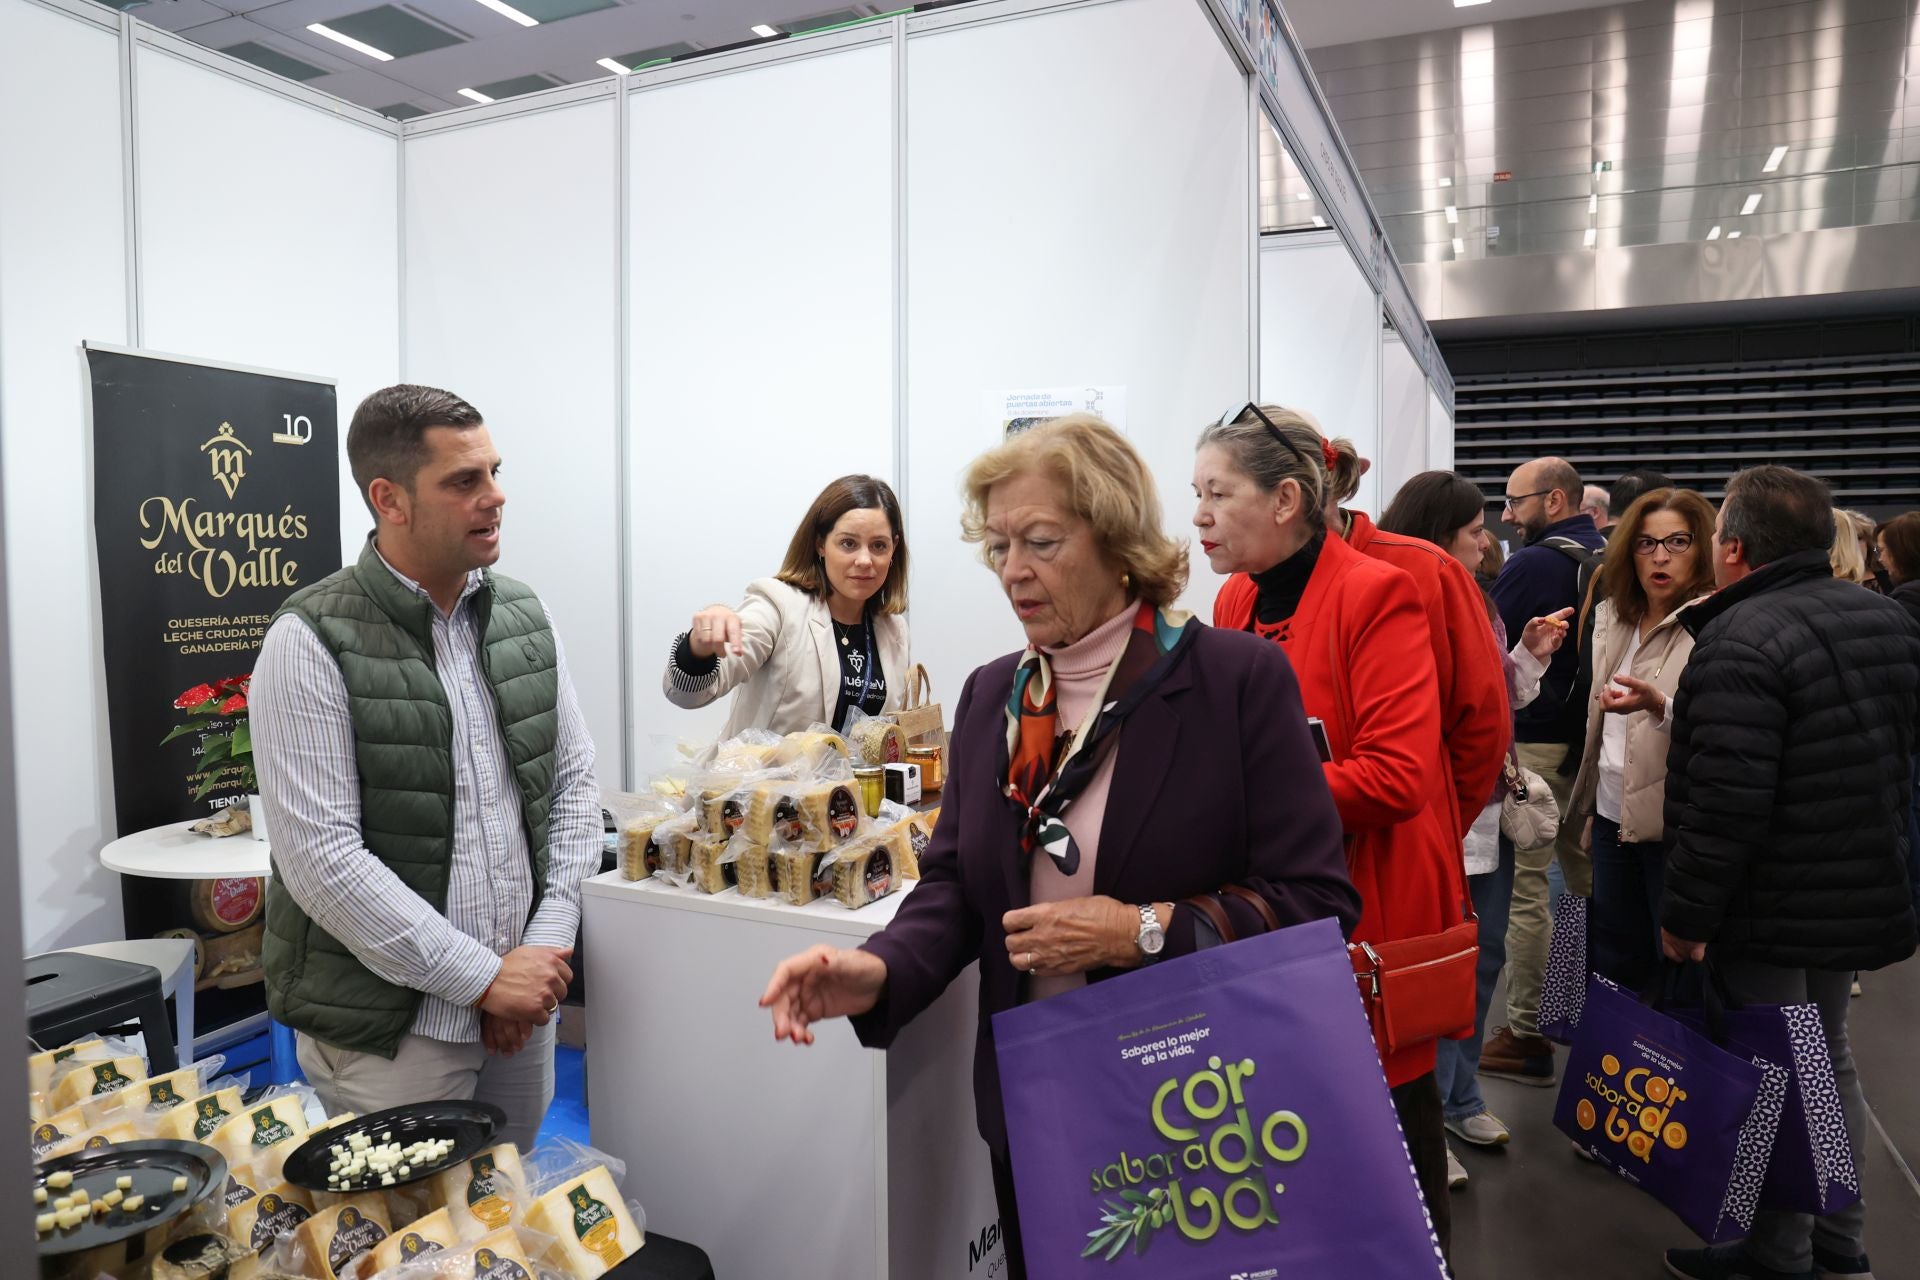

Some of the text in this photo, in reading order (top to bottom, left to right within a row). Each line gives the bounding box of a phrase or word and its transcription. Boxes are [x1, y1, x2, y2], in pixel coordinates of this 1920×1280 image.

[139, 496, 308, 552] Marqués
[154, 547, 299, 598] del Valle
[163, 627, 265, 643] LECHE CRUDA DE
[168, 614, 272, 629] QUESERÍA ARTES
[180, 639, 250, 655] GANADERÍA
[1121, 1027, 1210, 1059] Saborea lo mejor
[1632, 1040, 1660, 1059] Saborea
[1667, 1059, 1684, 1071] mejor
[1641, 1052, 1650, 1060] de
[1141, 1053, 1156, 1065] de
[1157, 1051, 1168, 1061] la
[253, 1203, 296, 1236] Marqués
[331, 1220, 374, 1249] Marqués
